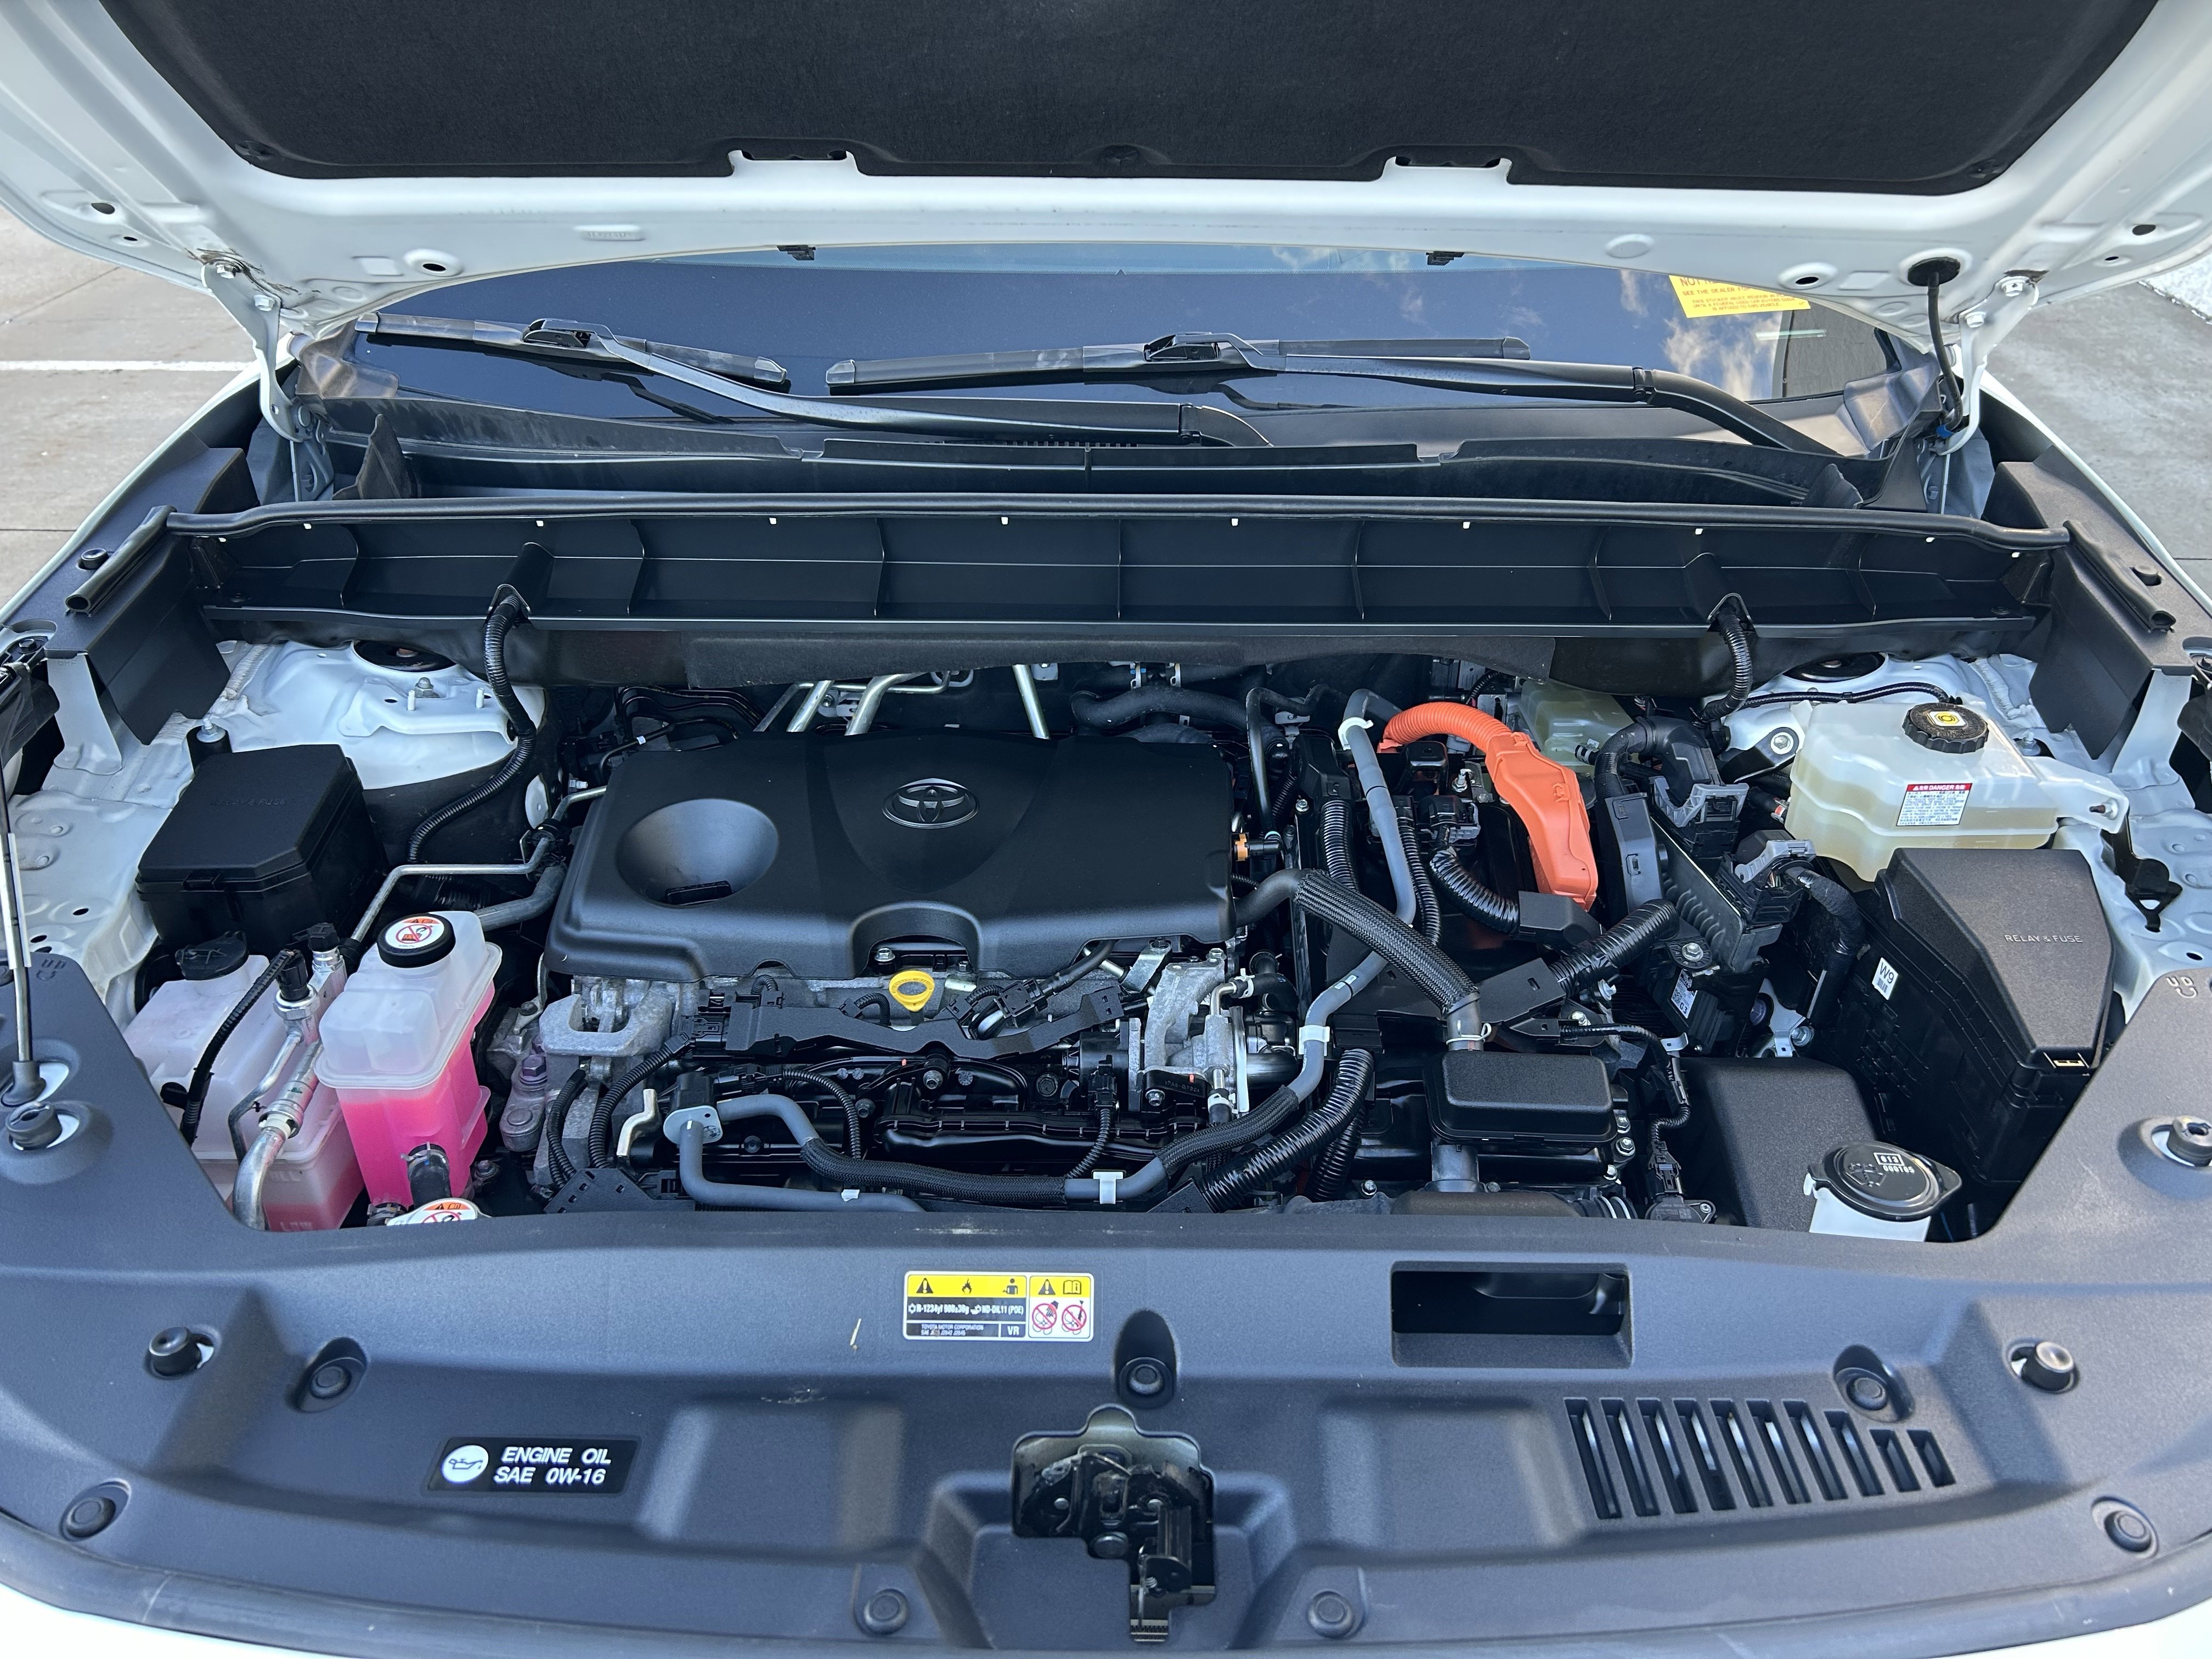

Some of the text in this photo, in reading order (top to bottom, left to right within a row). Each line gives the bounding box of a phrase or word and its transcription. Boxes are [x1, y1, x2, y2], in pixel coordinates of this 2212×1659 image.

[2004, 934, 2040, 943] RELAY
[2052, 935, 2083, 943] FUSE
[1880, 961, 1894, 984] W9
[1008, 1305, 1024, 1315] (POE)
[1007, 1325, 1019, 1335] VR
[501, 1447, 612, 1465] ENGINE OIL
[493, 1466, 606, 1485] SAE 0W-16
